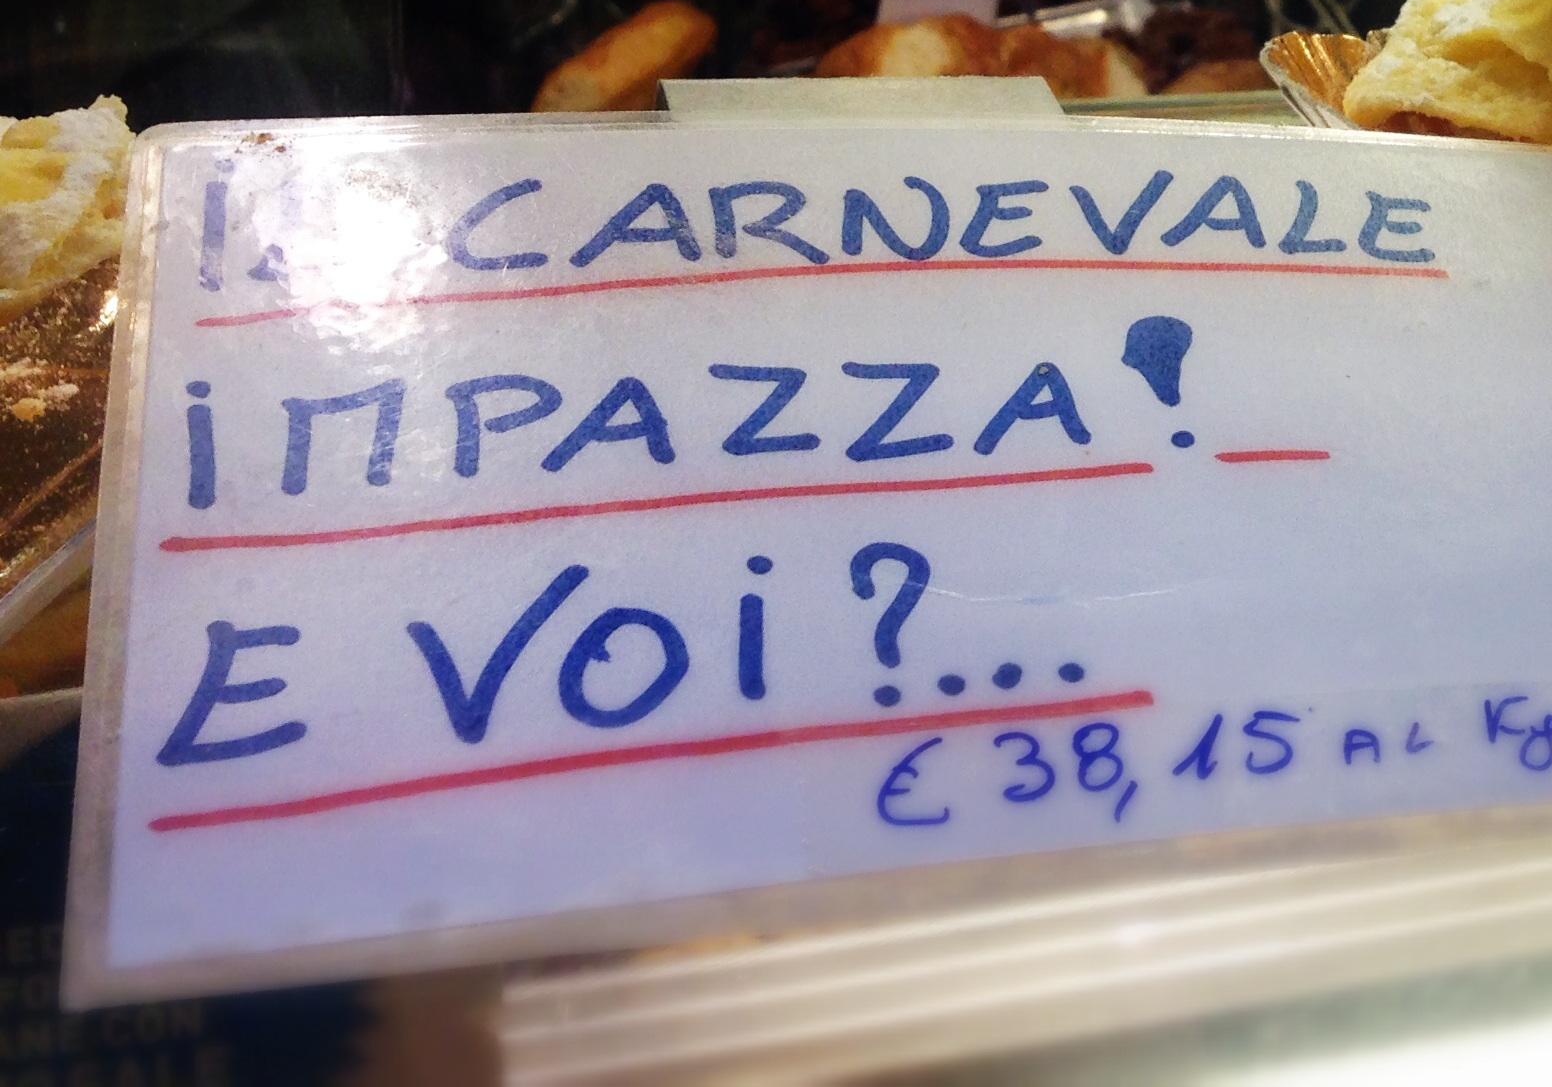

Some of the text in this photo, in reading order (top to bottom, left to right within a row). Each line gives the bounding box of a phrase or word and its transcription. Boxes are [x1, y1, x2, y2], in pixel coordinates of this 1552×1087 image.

[447, 169, 1437, 272] CARNEVALE
[155, 618, 308, 768] E
[875, 737, 952, 828] €
[992, 711, 1302, 823] 38,15
